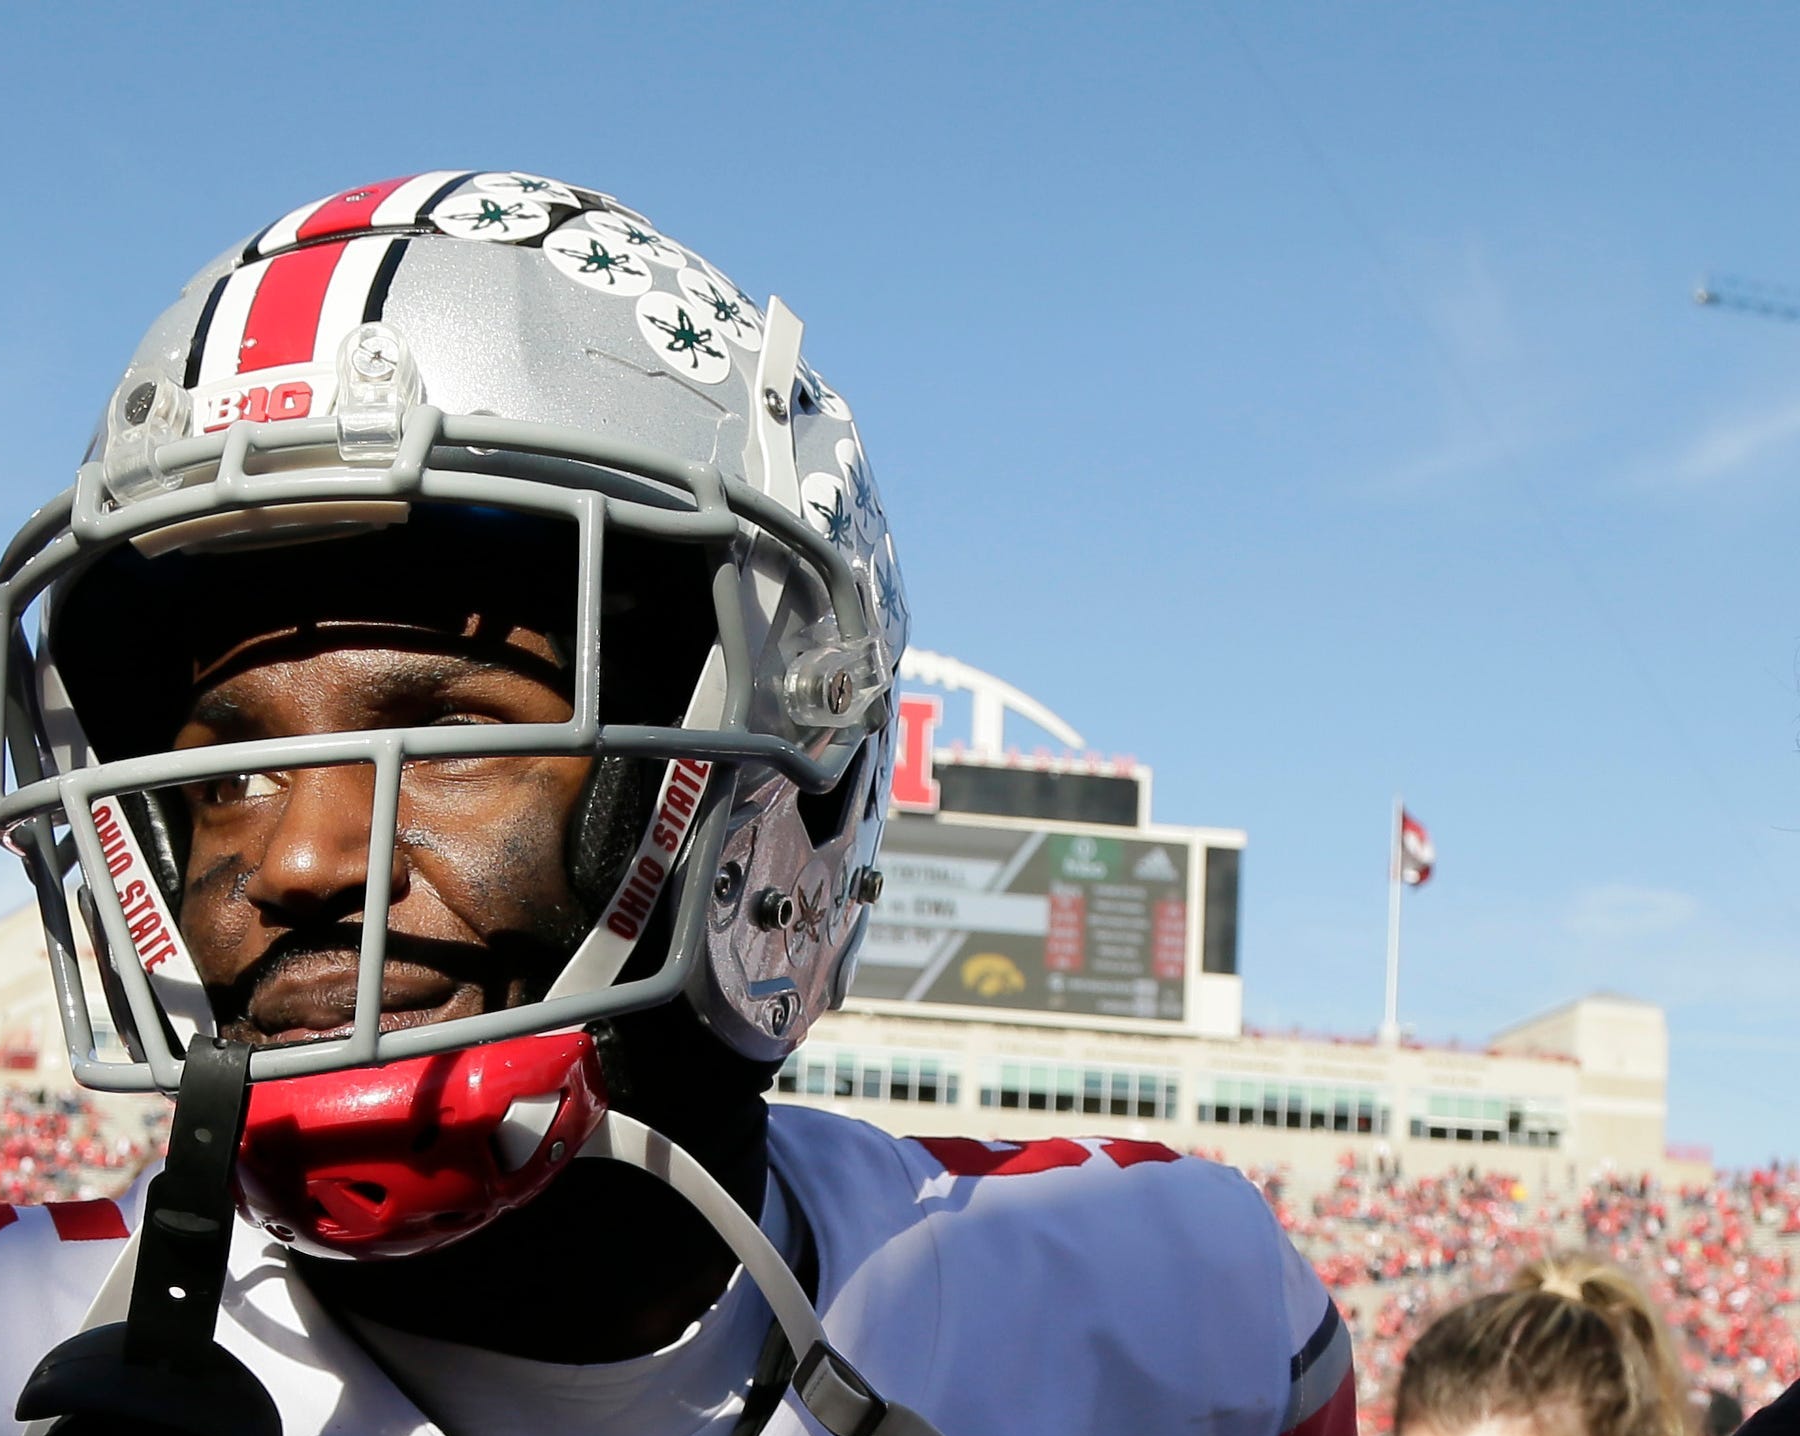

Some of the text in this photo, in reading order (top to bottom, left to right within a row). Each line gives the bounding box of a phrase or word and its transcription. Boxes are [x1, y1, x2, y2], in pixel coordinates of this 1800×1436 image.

[91, 805, 179, 975] OHIO STATE
[606, 758, 710, 942] OHIO STATE
